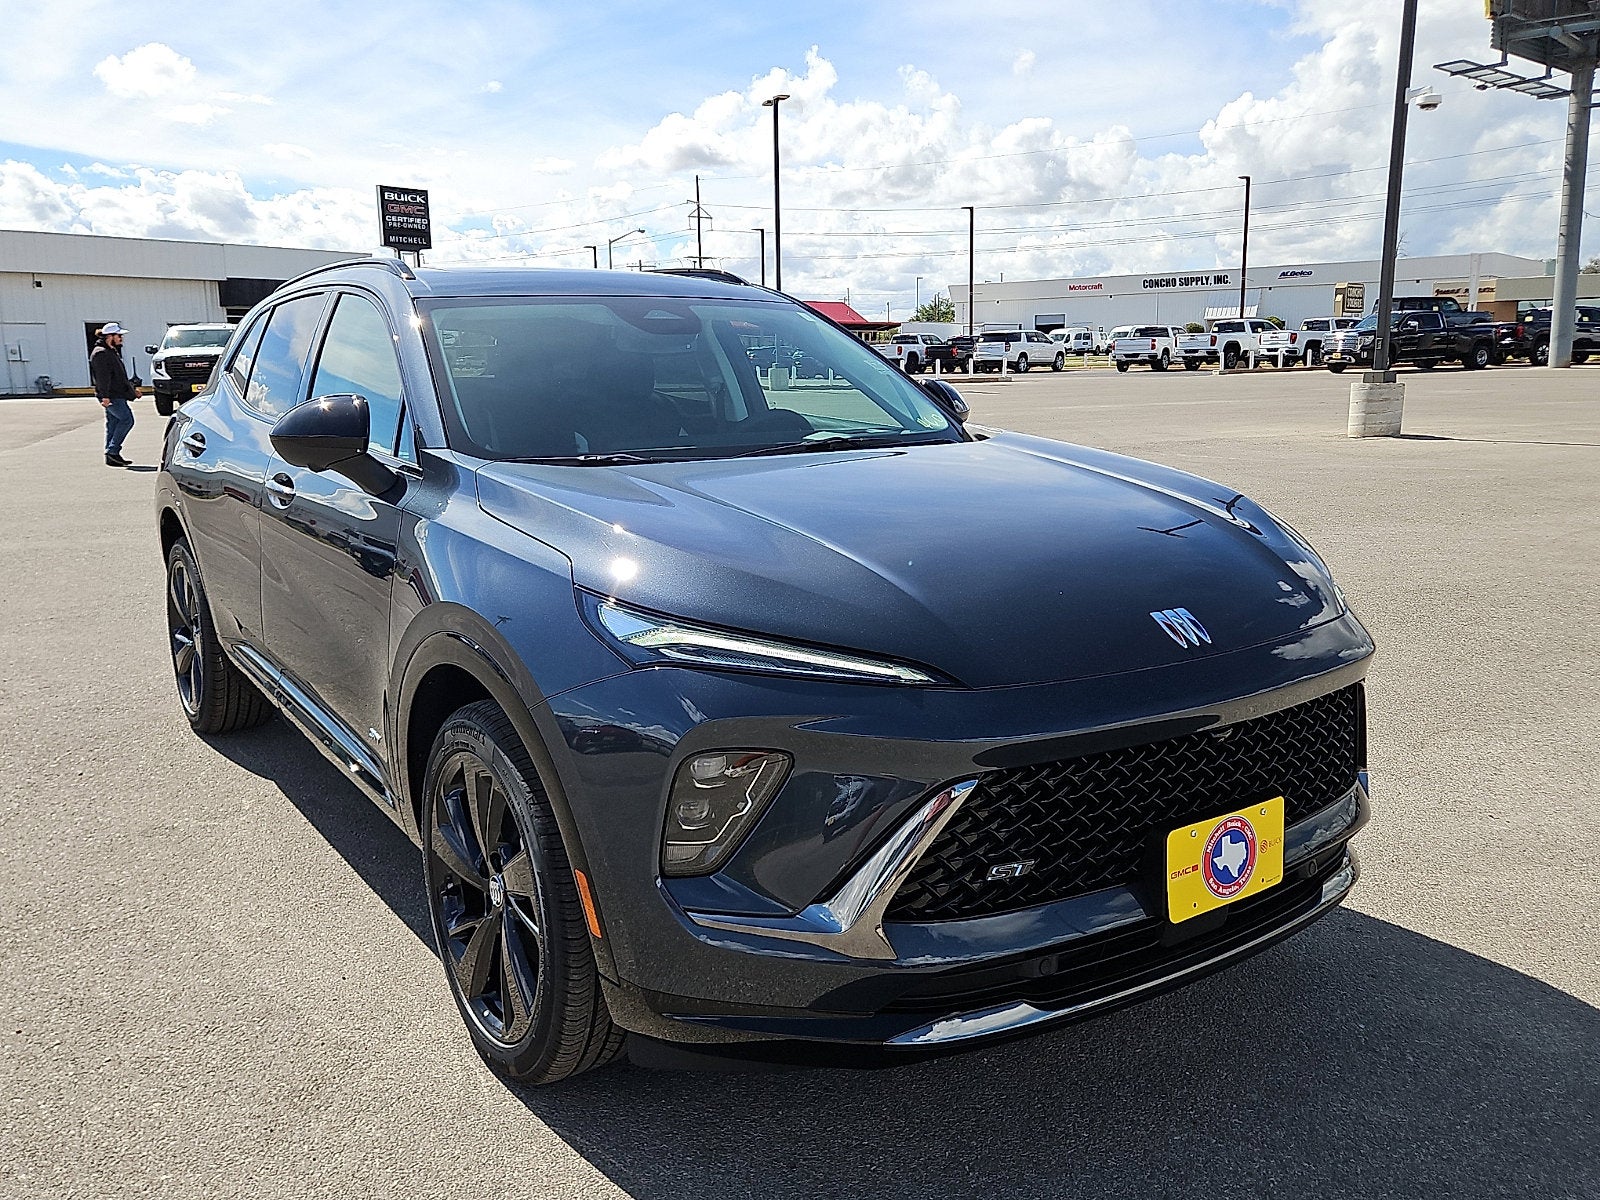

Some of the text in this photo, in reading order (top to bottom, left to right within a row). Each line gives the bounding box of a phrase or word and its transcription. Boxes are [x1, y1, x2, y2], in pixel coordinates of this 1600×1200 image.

[384, 192, 426, 203] BUICK
[388, 203, 425, 215] GMC
[386, 215, 428, 224] CERTIFIED
[388, 221, 426, 230] PRE-OWNED
[389, 235, 427, 245] MITCHELL
[1068, 283, 1103, 291] Motorcraft
[1142, 274, 1231, 289] CONCHO SUPPLY, INC.
[1206, 826, 1226, 853] Mitchell
[986, 859, 1035, 881] ST
[1170, 866, 1191, 879] GMC
